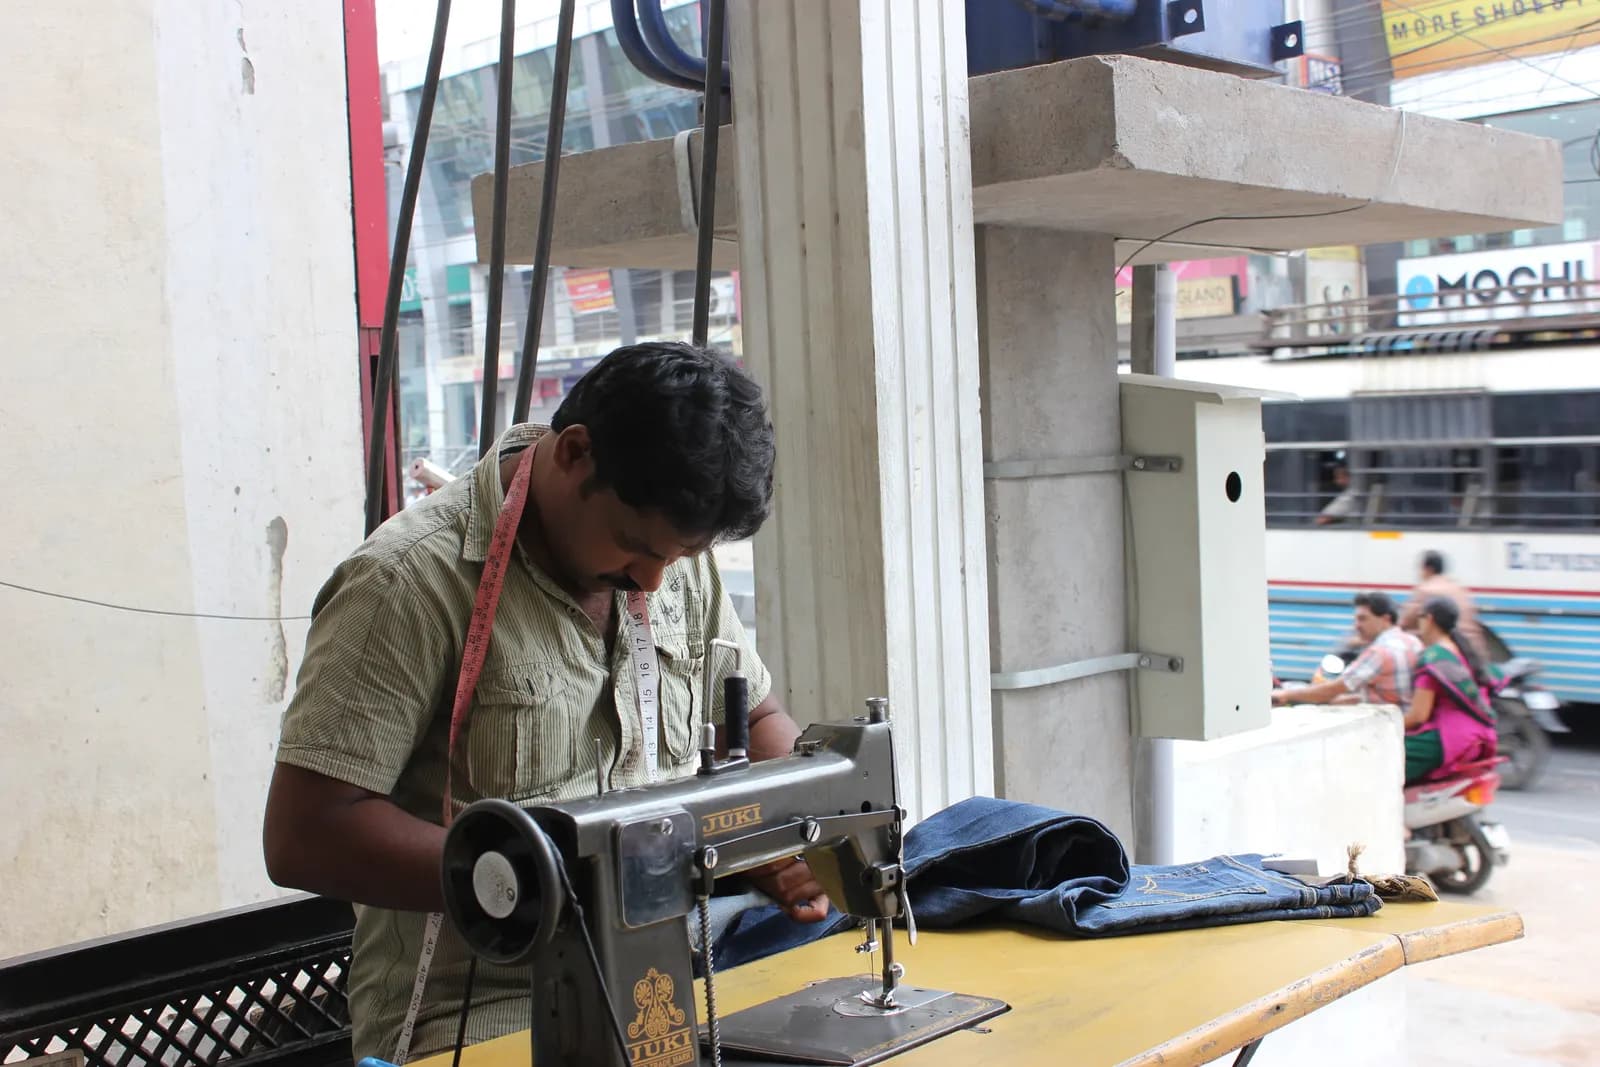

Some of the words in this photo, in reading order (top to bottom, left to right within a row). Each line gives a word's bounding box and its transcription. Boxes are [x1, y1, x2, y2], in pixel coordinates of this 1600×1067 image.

[1392, 11, 1465, 40] MORE
[633, 611, 643, 628] 18
[636, 637, 647, 652] 17
[640, 662, 650, 678] 16
[643, 688, 653, 704] 15
[646, 716, 655, 730] 14
[703, 806, 762, 833] JUKI
[631, 1031, 692, 1061] JUKI
